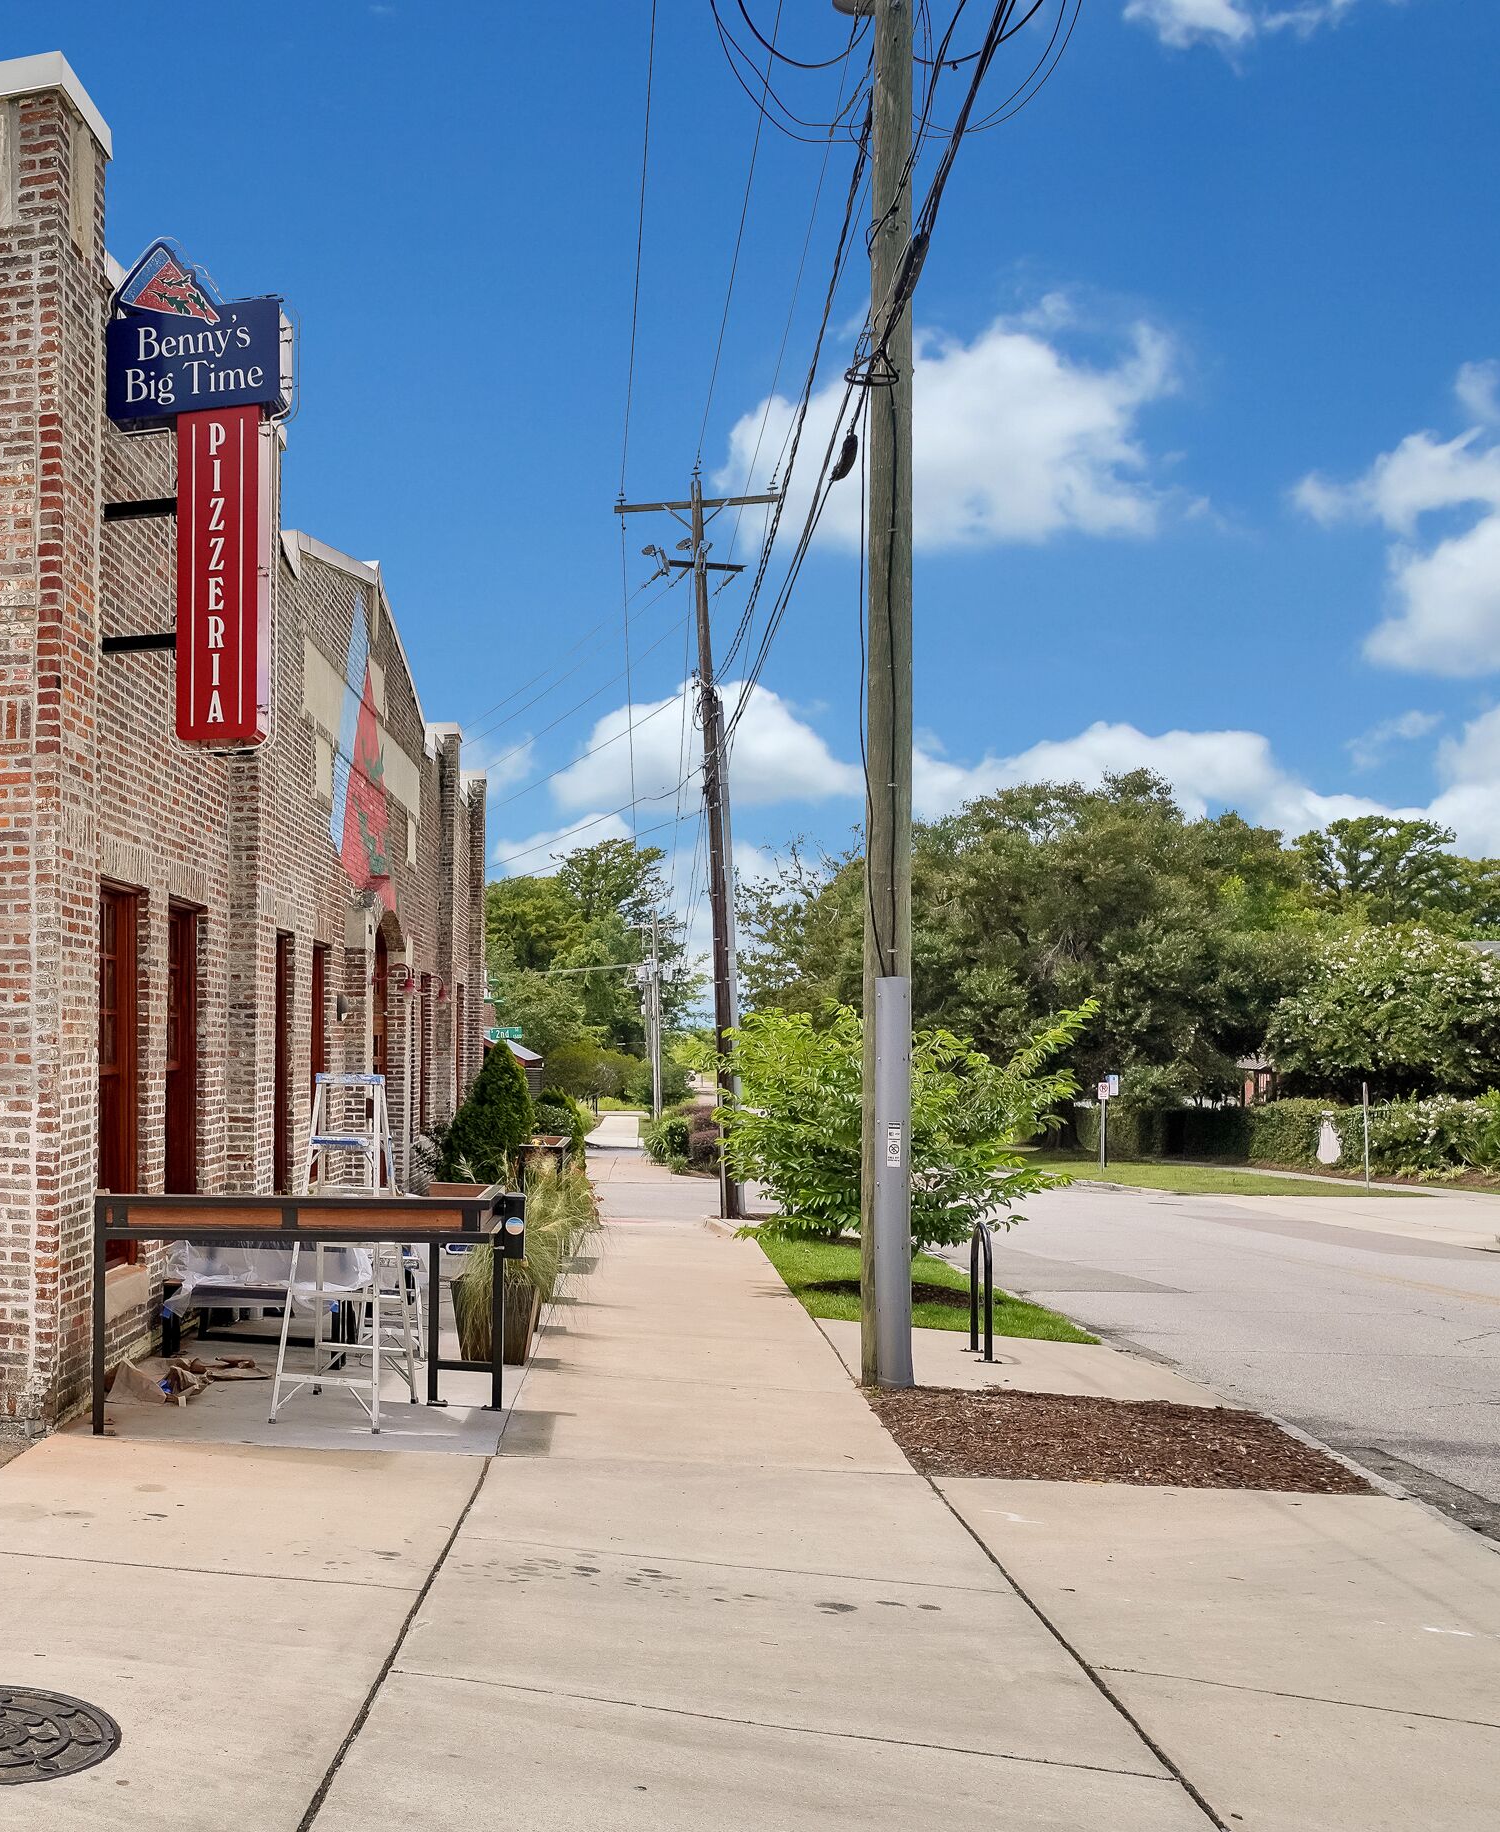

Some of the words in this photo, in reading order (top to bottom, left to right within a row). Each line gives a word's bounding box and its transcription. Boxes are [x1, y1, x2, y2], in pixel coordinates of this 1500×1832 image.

[137, 314, 251, 361] Benny's
[125, 368, 175, 405] Big
[182, 360, 264, 394] Time
[207, 422, 226, 723] PIZZERIA
[495, 1030, 510, 1038] 2nd
